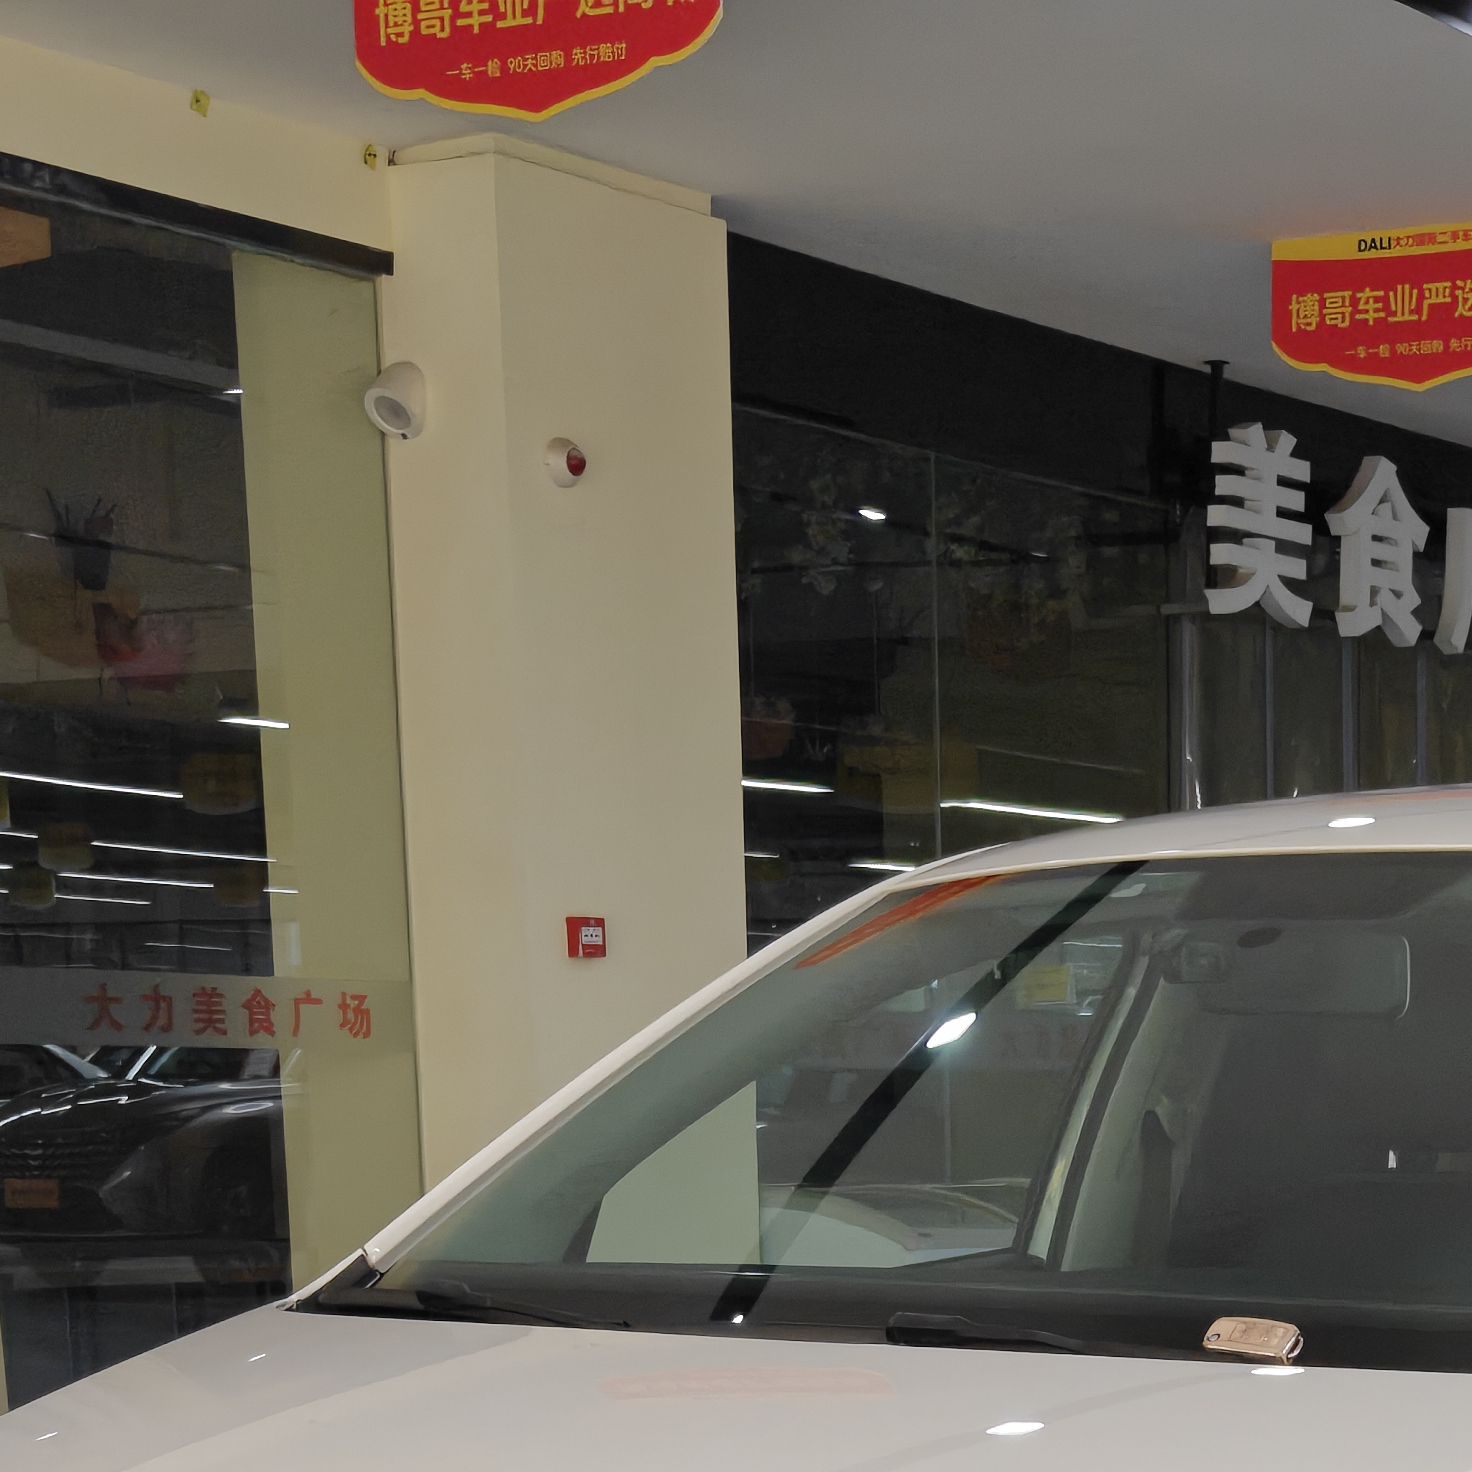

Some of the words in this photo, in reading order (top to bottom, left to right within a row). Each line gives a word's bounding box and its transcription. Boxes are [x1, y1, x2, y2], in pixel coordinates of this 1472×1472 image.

[83, 981, 372, 1039] 大力美食广场
